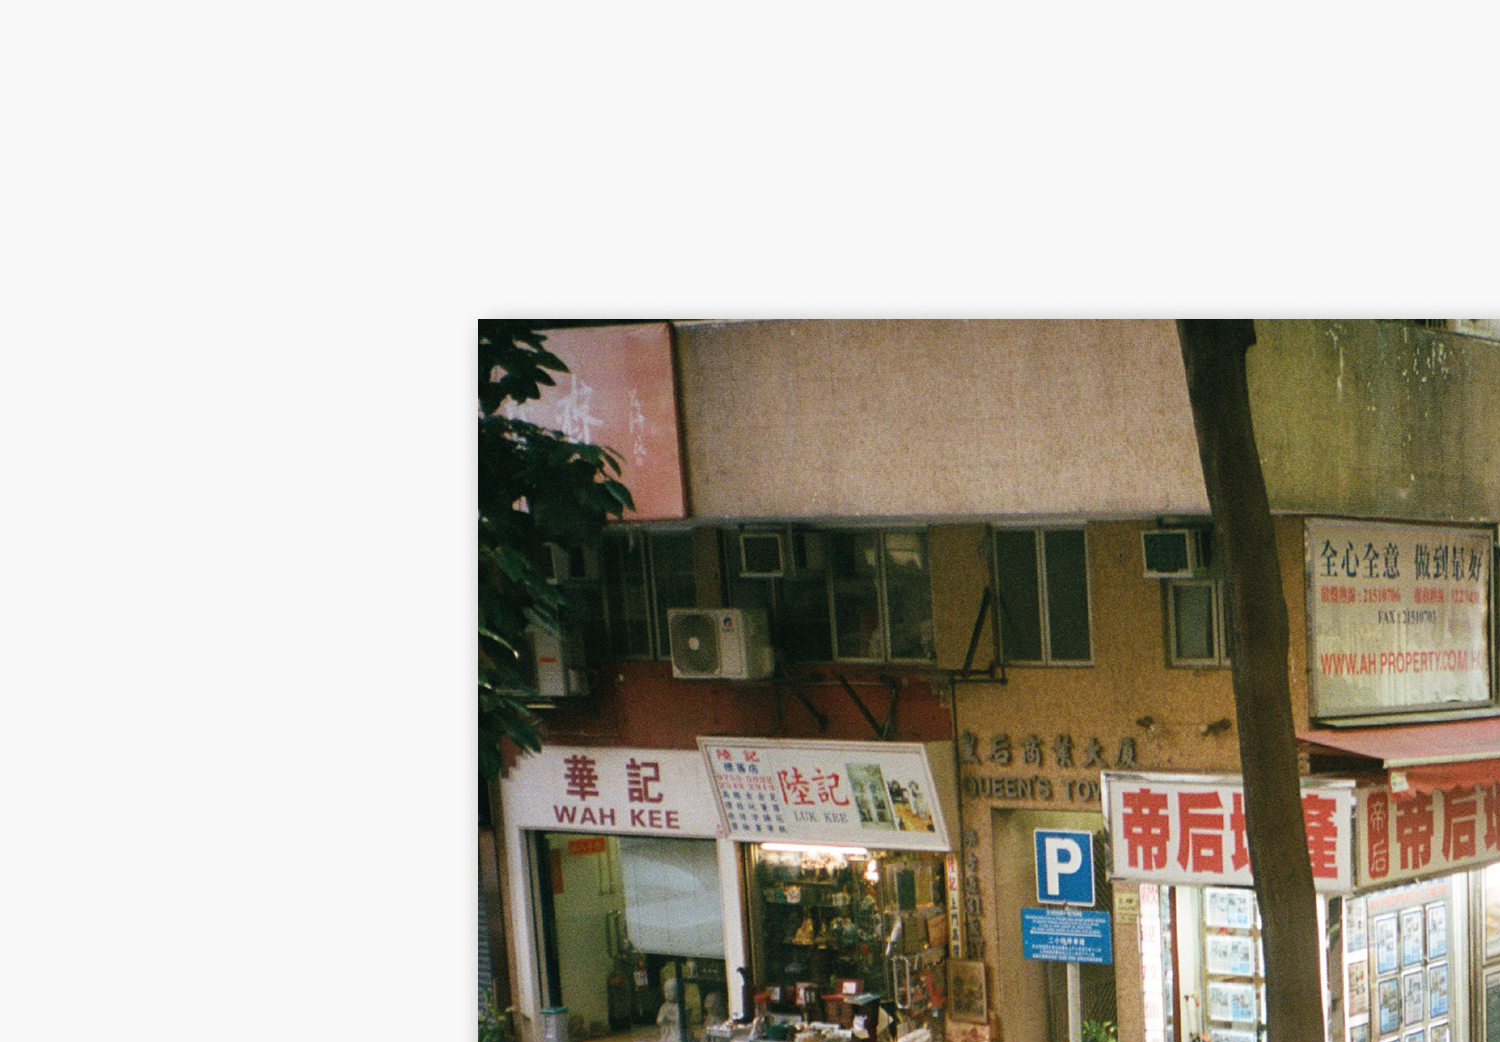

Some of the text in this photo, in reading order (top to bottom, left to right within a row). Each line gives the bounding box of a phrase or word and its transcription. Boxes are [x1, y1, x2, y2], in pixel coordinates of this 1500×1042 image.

[1320, 539, 1484, 582] 全心全意 做到最好
[960, 730, 1140, 769] 皇后商業大廈
[564, 754, 664, 804] 華記
[777, 766, 850, 806] 陸記
[961, 775, 1051, 800] QUEEN'S
[553, 805, 680, 829] WAH KEE
[794, 811, 849, 824] LUK KEE
[1045, 837, 1083, 896] P
